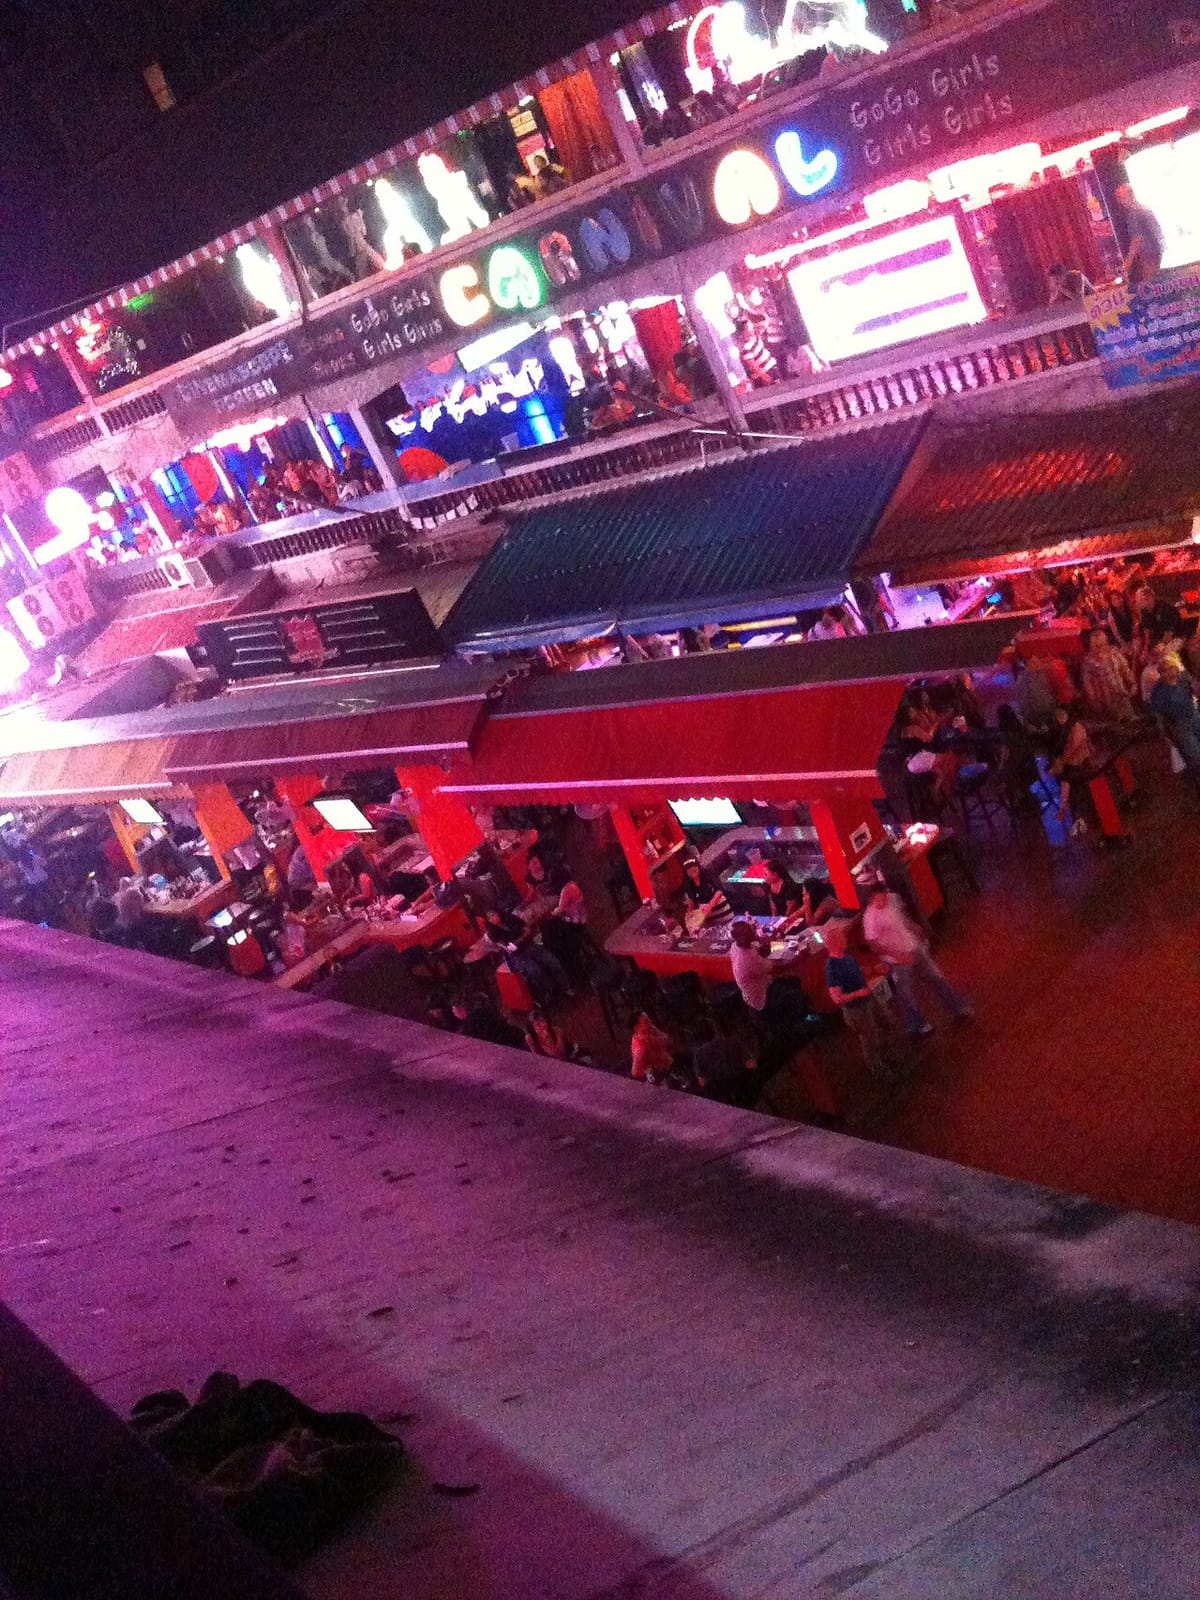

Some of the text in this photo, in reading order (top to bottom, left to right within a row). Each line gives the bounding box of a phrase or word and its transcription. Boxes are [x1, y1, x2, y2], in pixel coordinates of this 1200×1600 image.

[850, 53, 1000, 130] GoGo Girls
[863, 91, 1013, 166] Girls Girls
[438, 130, 839, 328] CARNIVAL
[351, 289, 431, 334] GoGo Girls
[362, 318, 443, 360] Girls Girls
